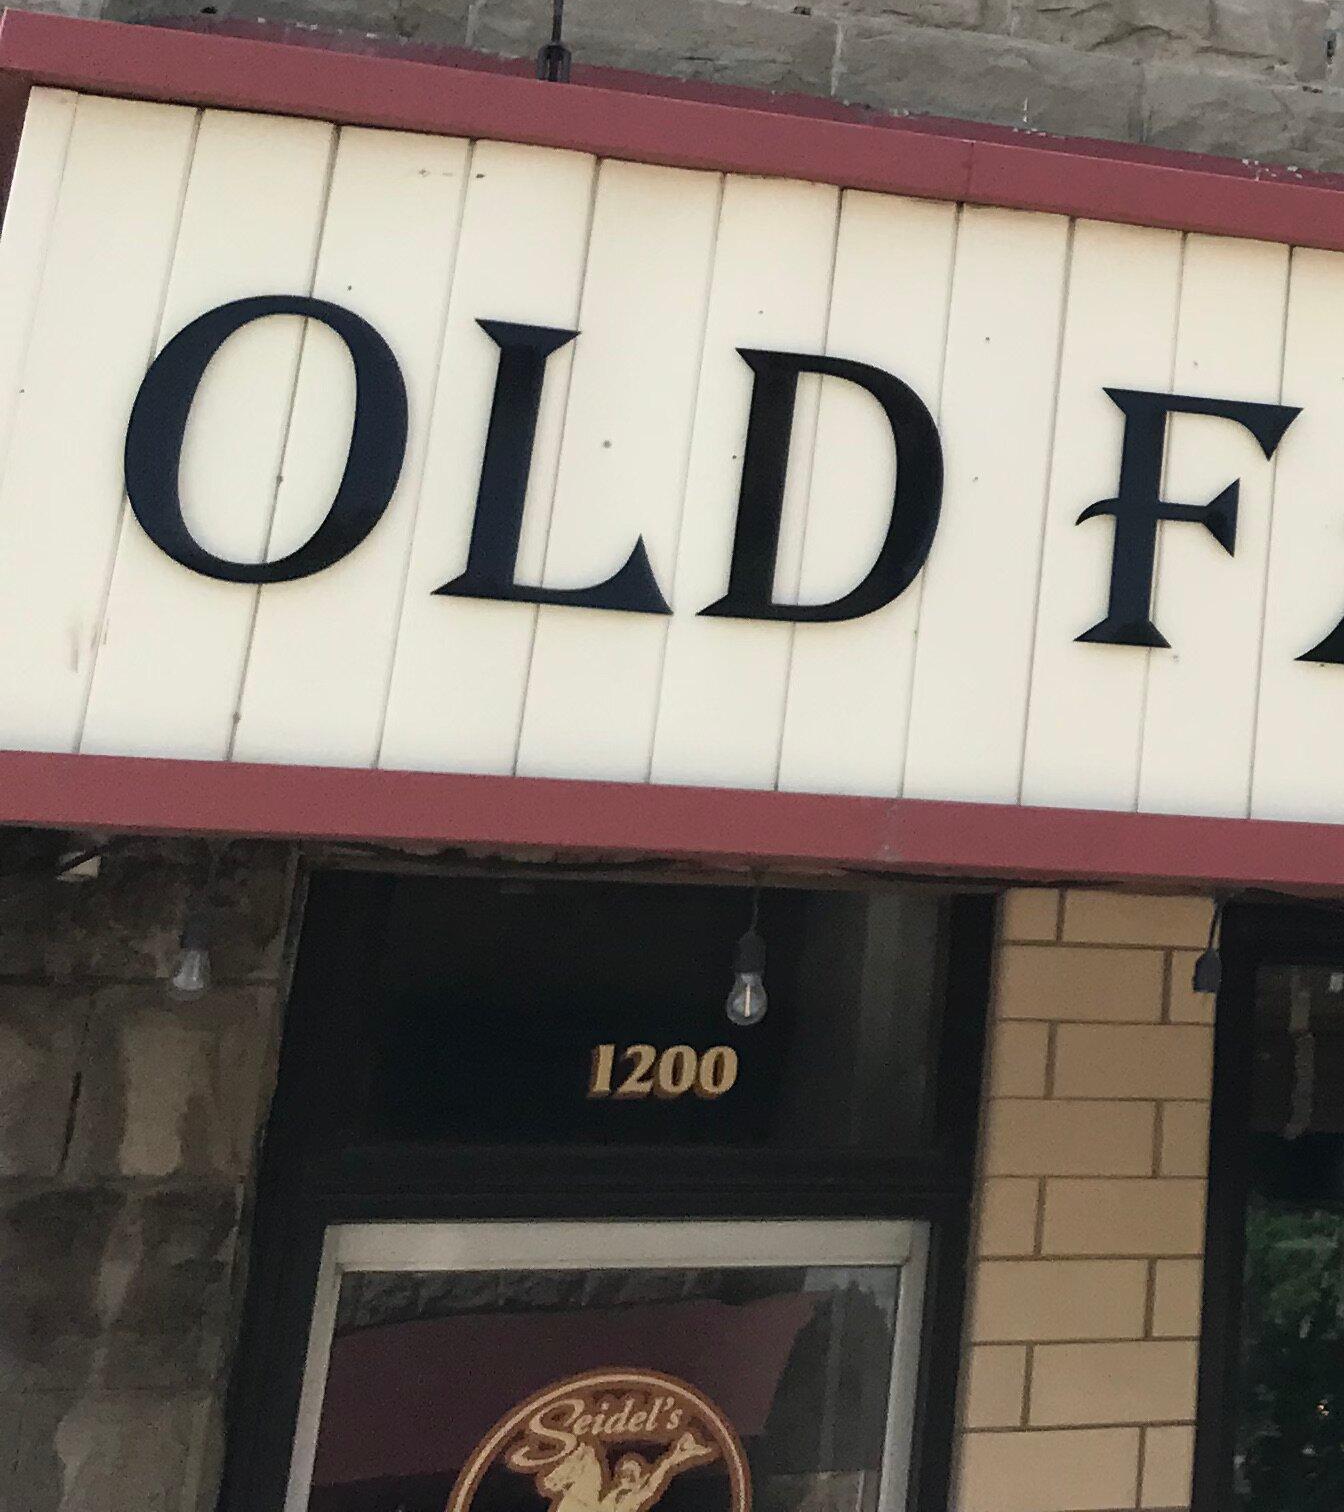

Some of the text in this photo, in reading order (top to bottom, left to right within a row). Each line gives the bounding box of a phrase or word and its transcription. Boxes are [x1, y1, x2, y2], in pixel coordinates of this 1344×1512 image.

[123, 293, 945, 624] OLD
[589, 1042, 740, 1100] 1200
[510, 1395, 685, 1468] Seidel's
